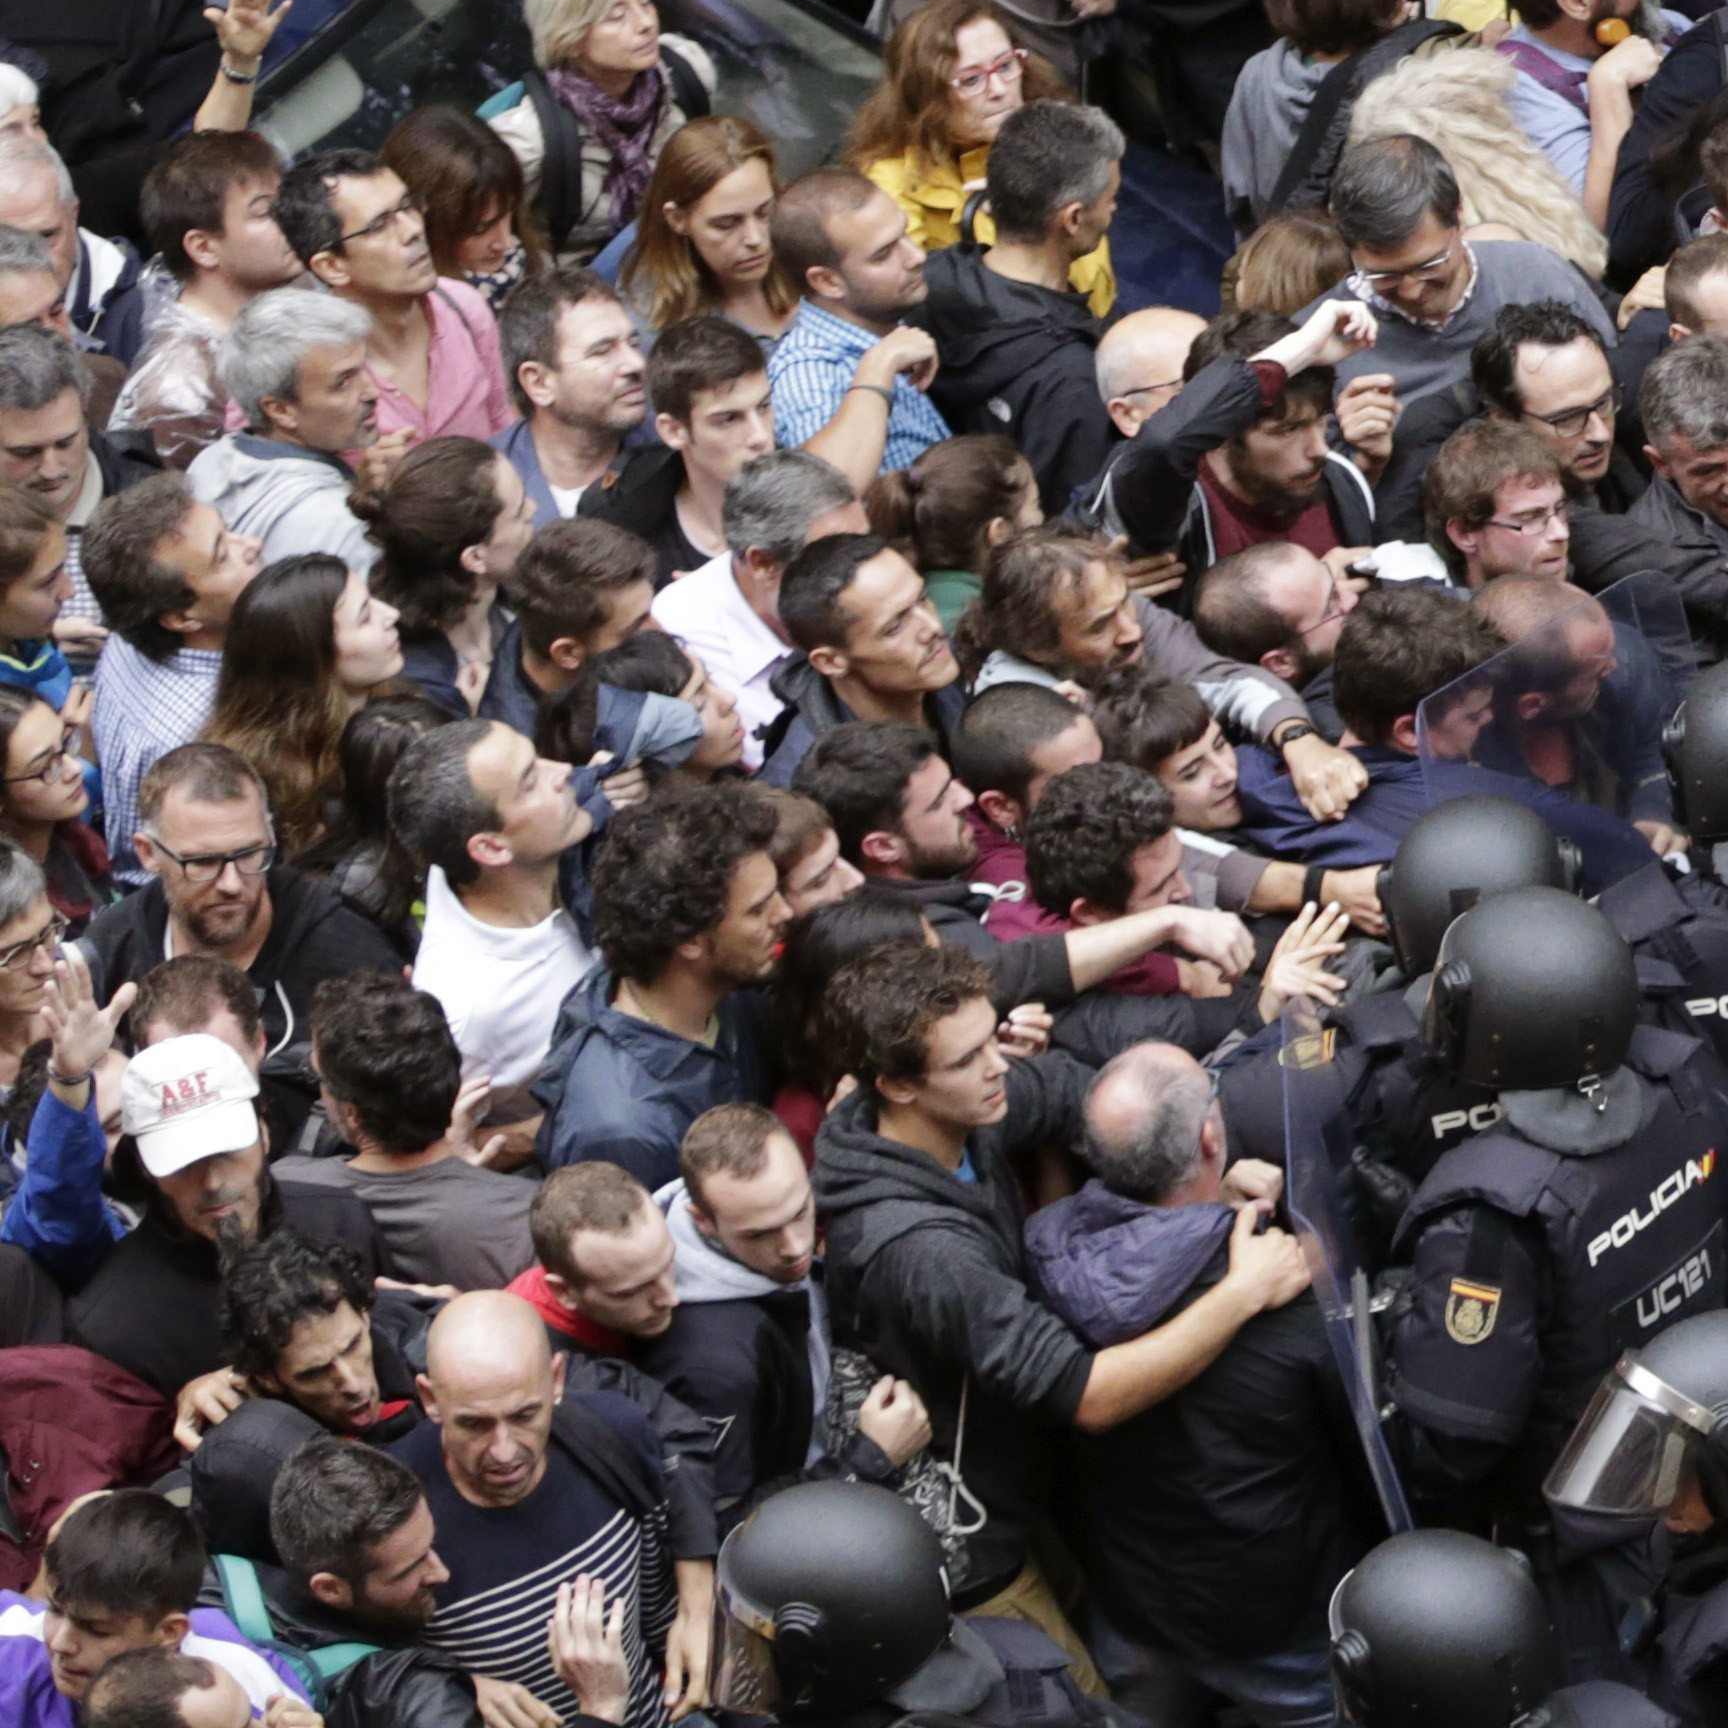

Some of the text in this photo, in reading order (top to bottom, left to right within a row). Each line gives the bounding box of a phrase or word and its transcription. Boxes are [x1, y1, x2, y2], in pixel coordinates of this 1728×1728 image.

[162, 1071, 207, 1110] A&F
[1587, 1158, 1703, 1269] POLICIA
[1636, 1247, 1713, 1328] UC121
